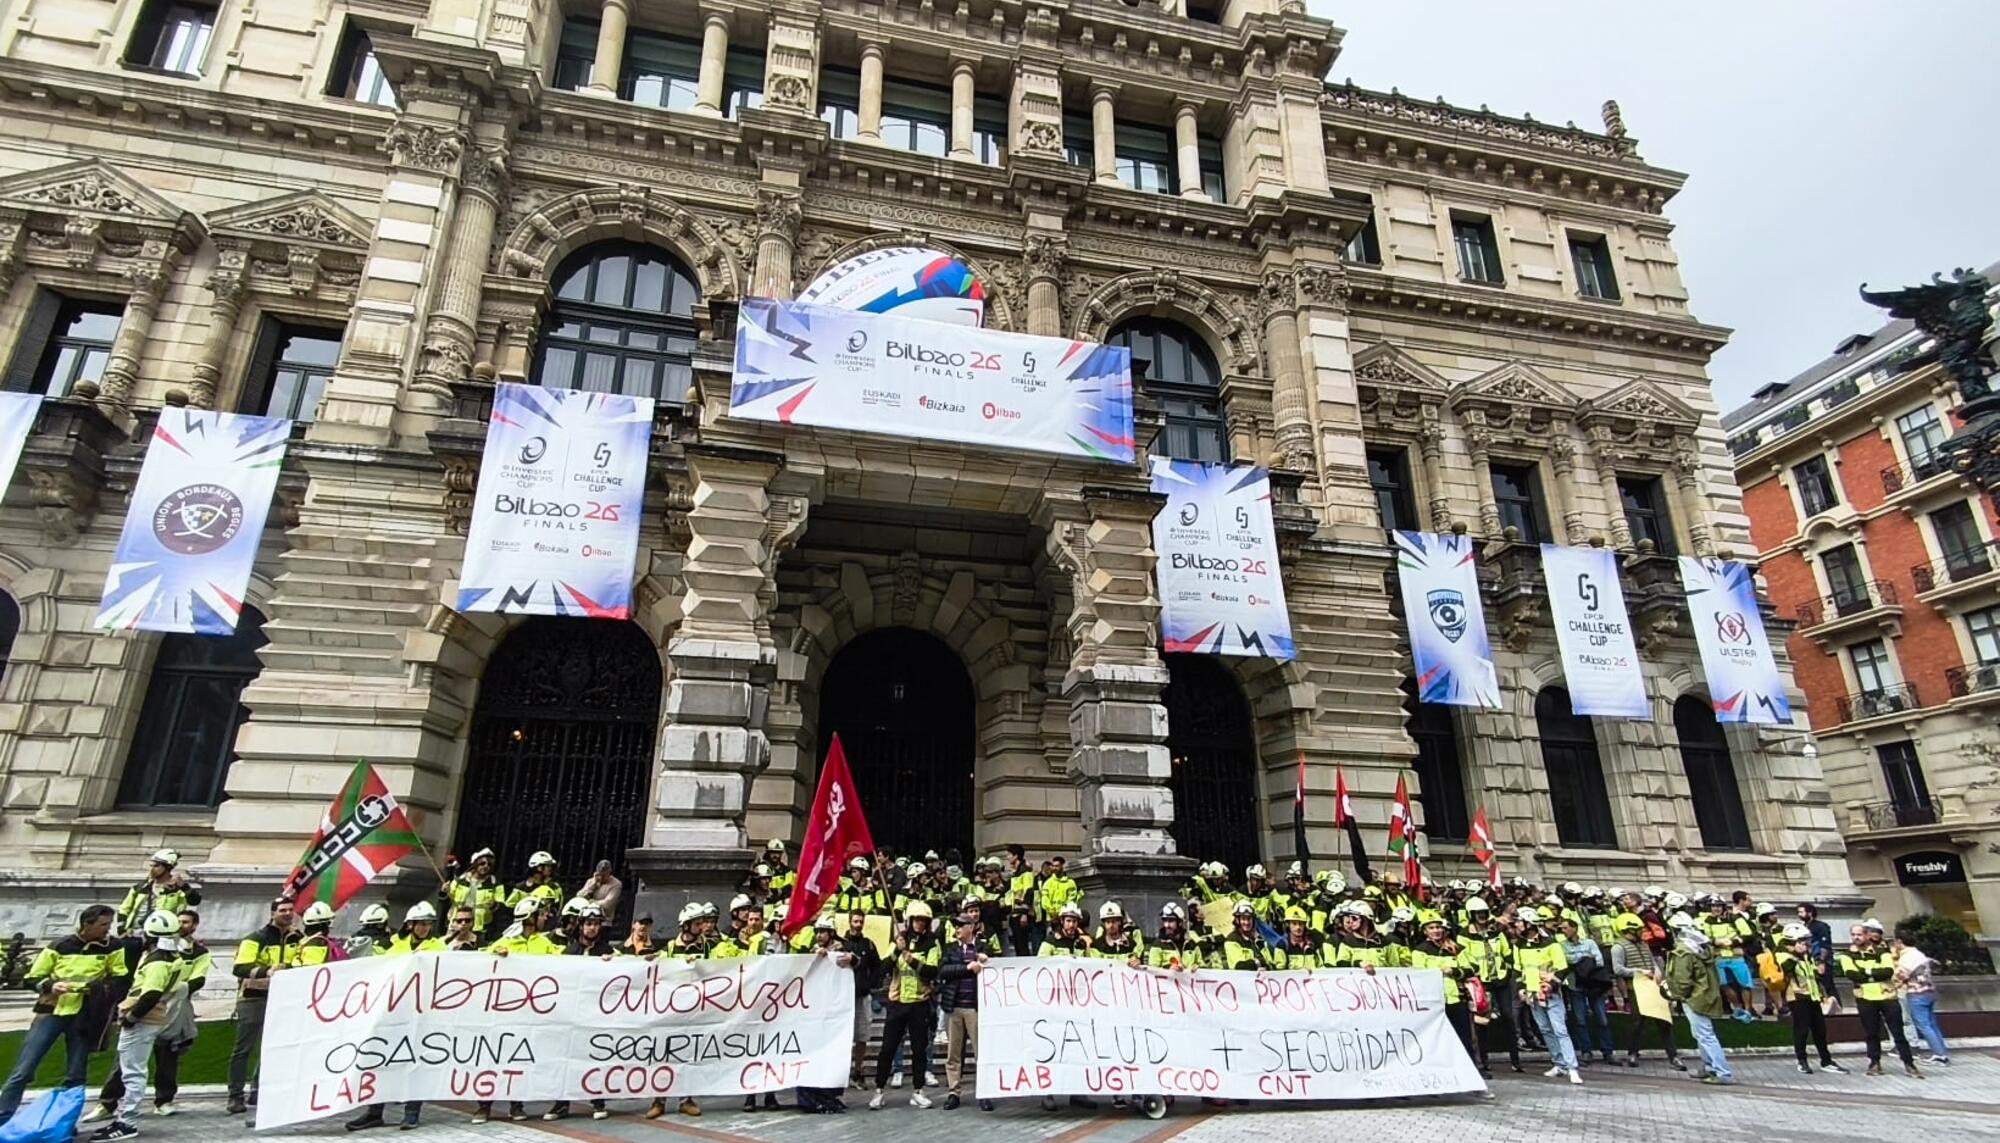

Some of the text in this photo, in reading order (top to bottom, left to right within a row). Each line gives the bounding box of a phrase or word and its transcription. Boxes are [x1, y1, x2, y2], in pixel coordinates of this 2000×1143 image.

[886, 340, 1002, 370] Bilbao 26
[914, 365, 974, 380] FINALS
[1011, 376, 1047, 388] CHALLENGE
[1023, 385, 1036, 393] CUP
[862, 388, 901, 399] EUSKADI
[926, 399, 965, 413] Bizkaia
[982, 402, 1021, 419] Bilbao
[573, 473, 623, 486] CHALLENGE
[176, 485, 234, 504] BORDEAUX
[588, 484, 607, 492] CUP
[494, 494, 621, 521] Bilbao 26
[156, 501, 174, 532] UNION
[523, 519, 588, 531] FINALS
[1226, 533, 1263, 544] CHALLENGE
[1171, 553, 1267, 575] Bilbao 26
[1198, 572, 1248, 584] FINALS
[1569, 620, 1624, 634] CHALLENGE
[1589, 634, 1608, 646] CUP
[1720, 647, 1757, 658] ULSTER
[1905, 861, 1948, 872] Freshly
[1033, 1018, 1170, 1065] SALUD
[325, 1032, 536, 1074] OSASUNA
[310, 1060, 811, 1110] LAB UGT CCOO CNT
[999, 1065, 1313, 1096] LAB UGT CCOO CNT
